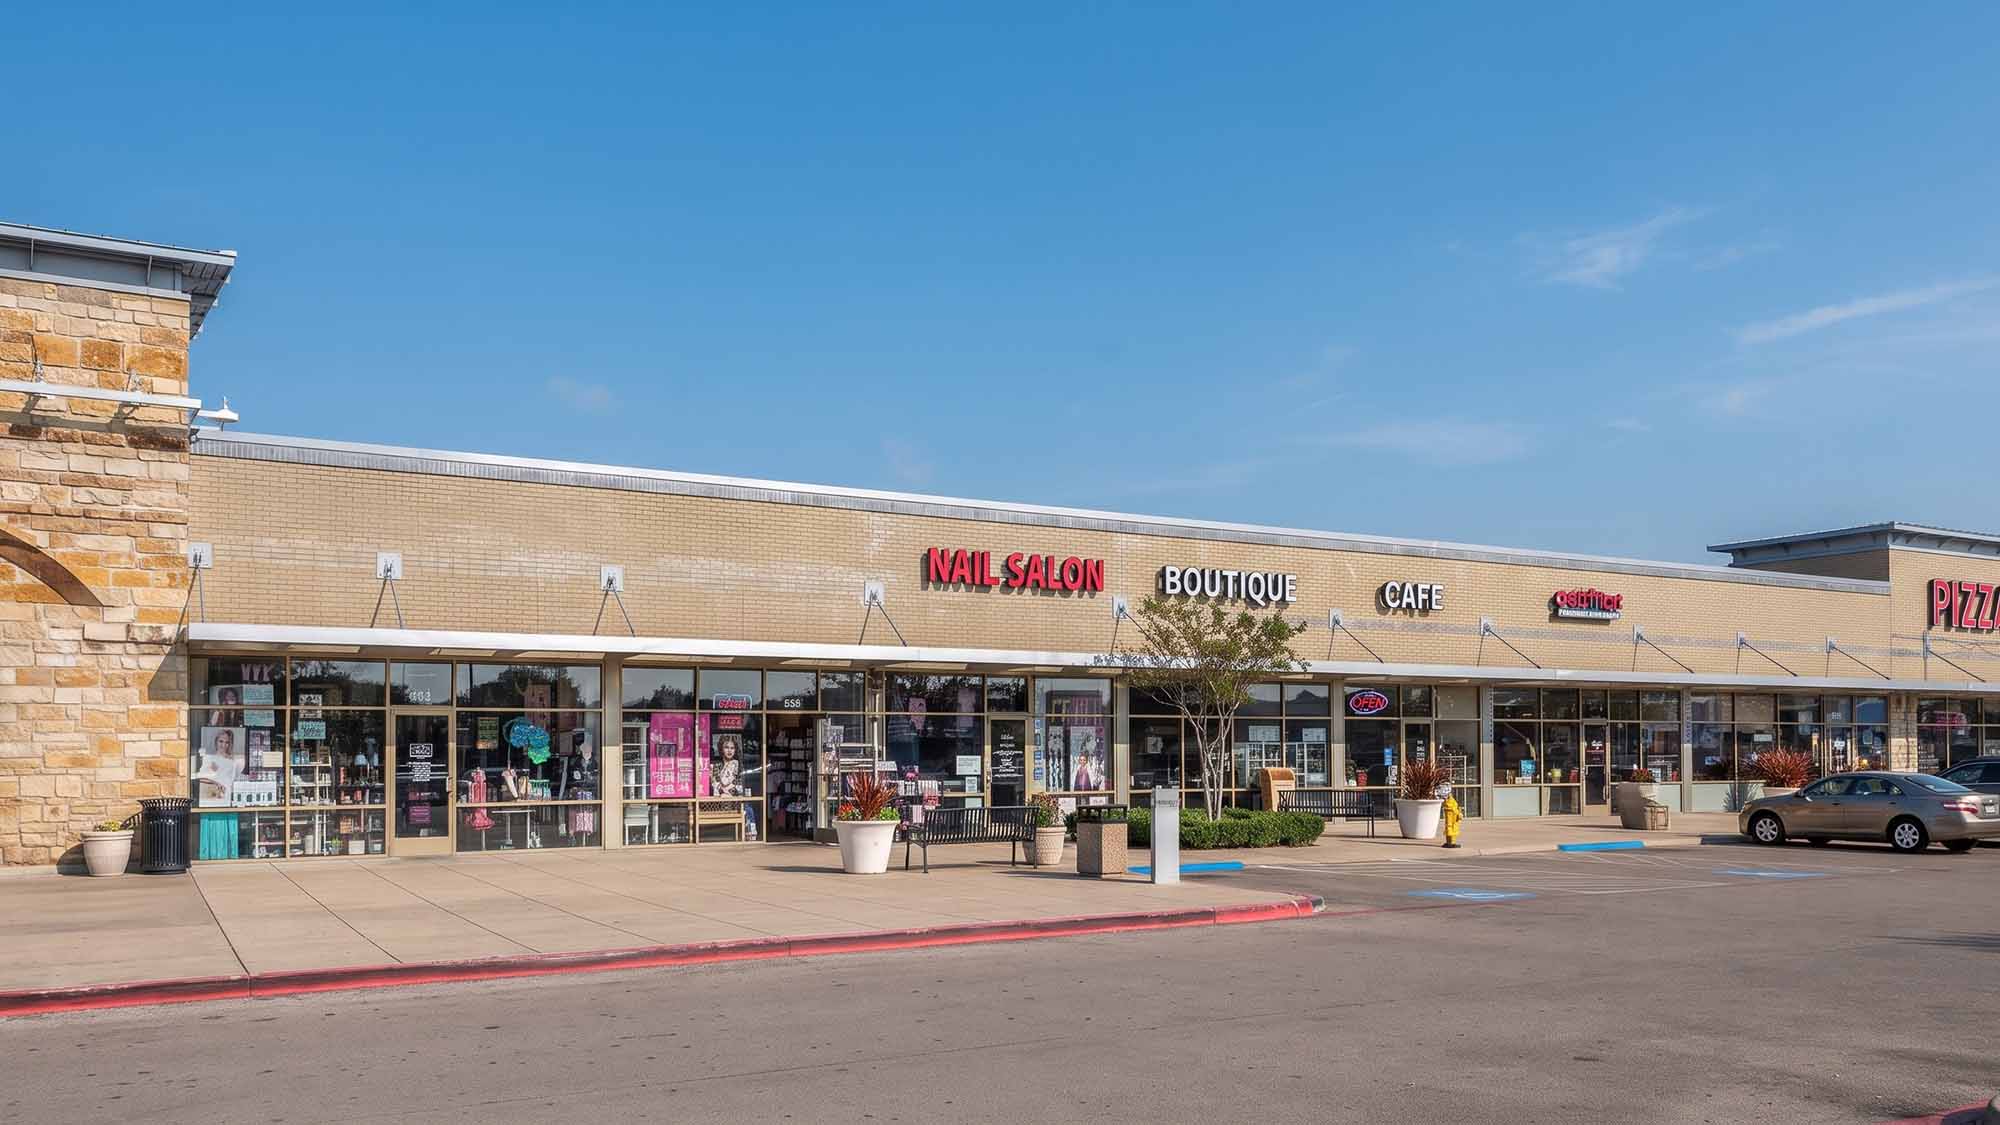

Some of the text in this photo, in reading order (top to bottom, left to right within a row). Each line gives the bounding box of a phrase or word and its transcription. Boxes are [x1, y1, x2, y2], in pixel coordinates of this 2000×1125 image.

[927, 547, 1105, 593] NAIL SALON
[1163, 565, 1297, 607] BOUTIQUE
[1384, 580, 1444, 610] CAFE
[1353, 696, 1386, 709] OPEN
